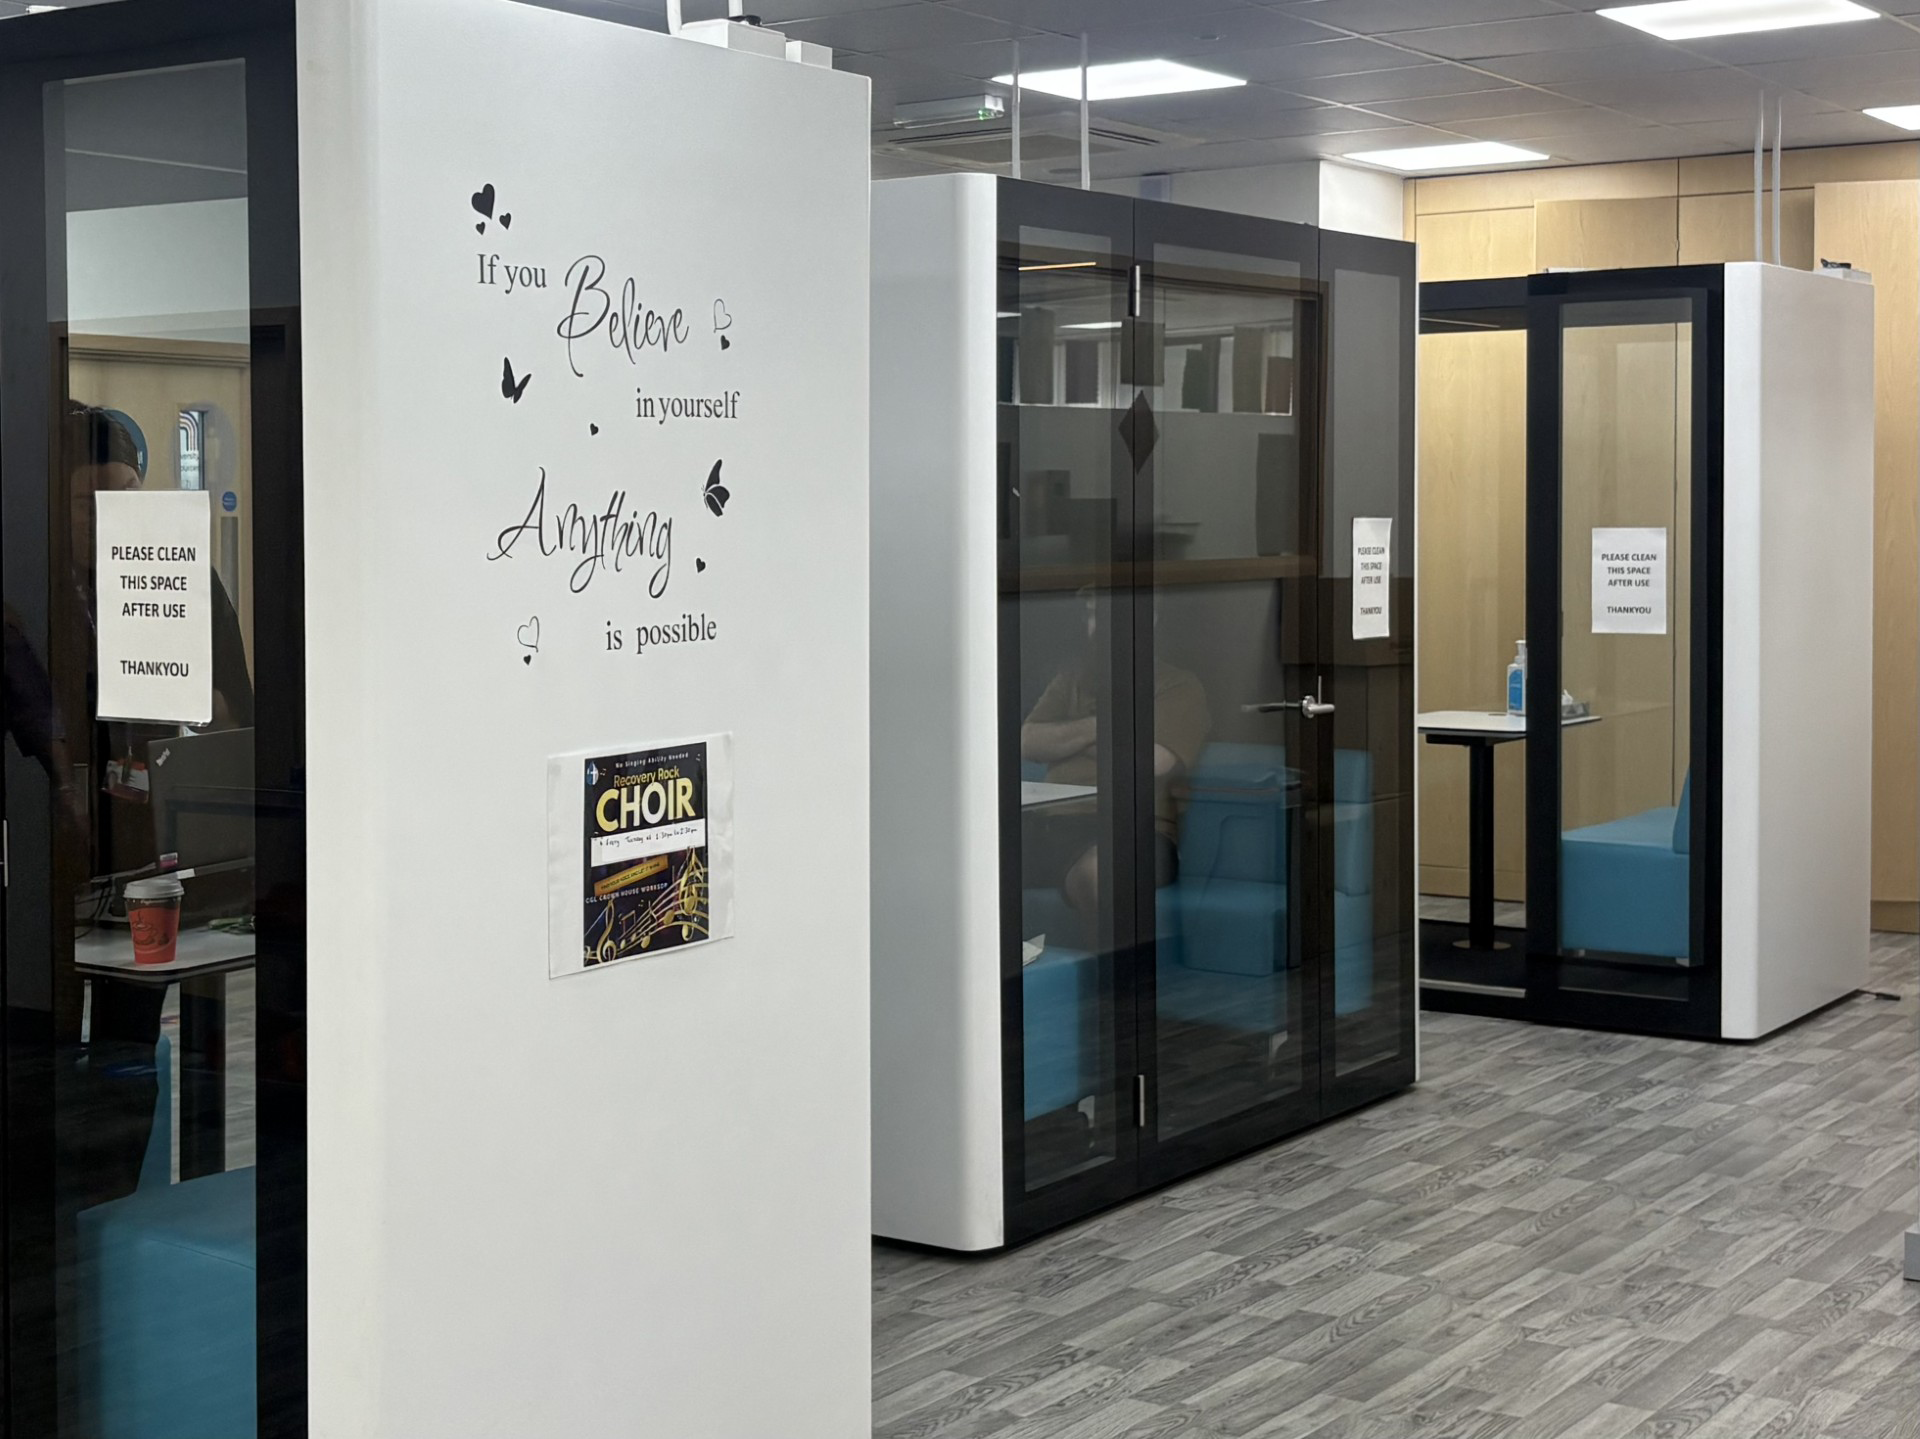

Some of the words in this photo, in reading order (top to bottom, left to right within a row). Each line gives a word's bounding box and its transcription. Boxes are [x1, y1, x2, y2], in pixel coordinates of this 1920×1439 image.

[477, 253, 500, 284] If
[504, 265, 547, 294] you
[557, 254, 690, 378] Believe
[636, 387, 655, 418] in
[659, 390, 741, 425] yourself
[486, 466, 673, 599] Anything
[111, 546, 154, 561] PLEASE
[157, 546, 196, 562] CLEAN
[1601, 553, 1630, 561] PLEASE
[1631, 553, 1657, 561] CLEAN
[1607, 566, 1625, 575] THIS
[1626, 566, 1651, 575] SPACE
[120, 575, 147, 590] THIS
[150, 575, 187, 591] SPACE
[1607, 579, 1633, 587] AFTER
[1635, 579, 1650, 587] USE
[122, 602, 159, 617] AFTER
[163, 603, 186, 618] USE
[1607, 606, 1652, 614] THANKYOU
[606, 620, 623, 651] is
[636, 613, 717, 655] possible
[120, 660, 189, 677] THANKYOU
[614, 771, 656, 788] Recovery
[658, 765, 680, 781] Rock
[595, 777, 696, 832] CHOIR
[620, 887, 640, 896] HOUSE
